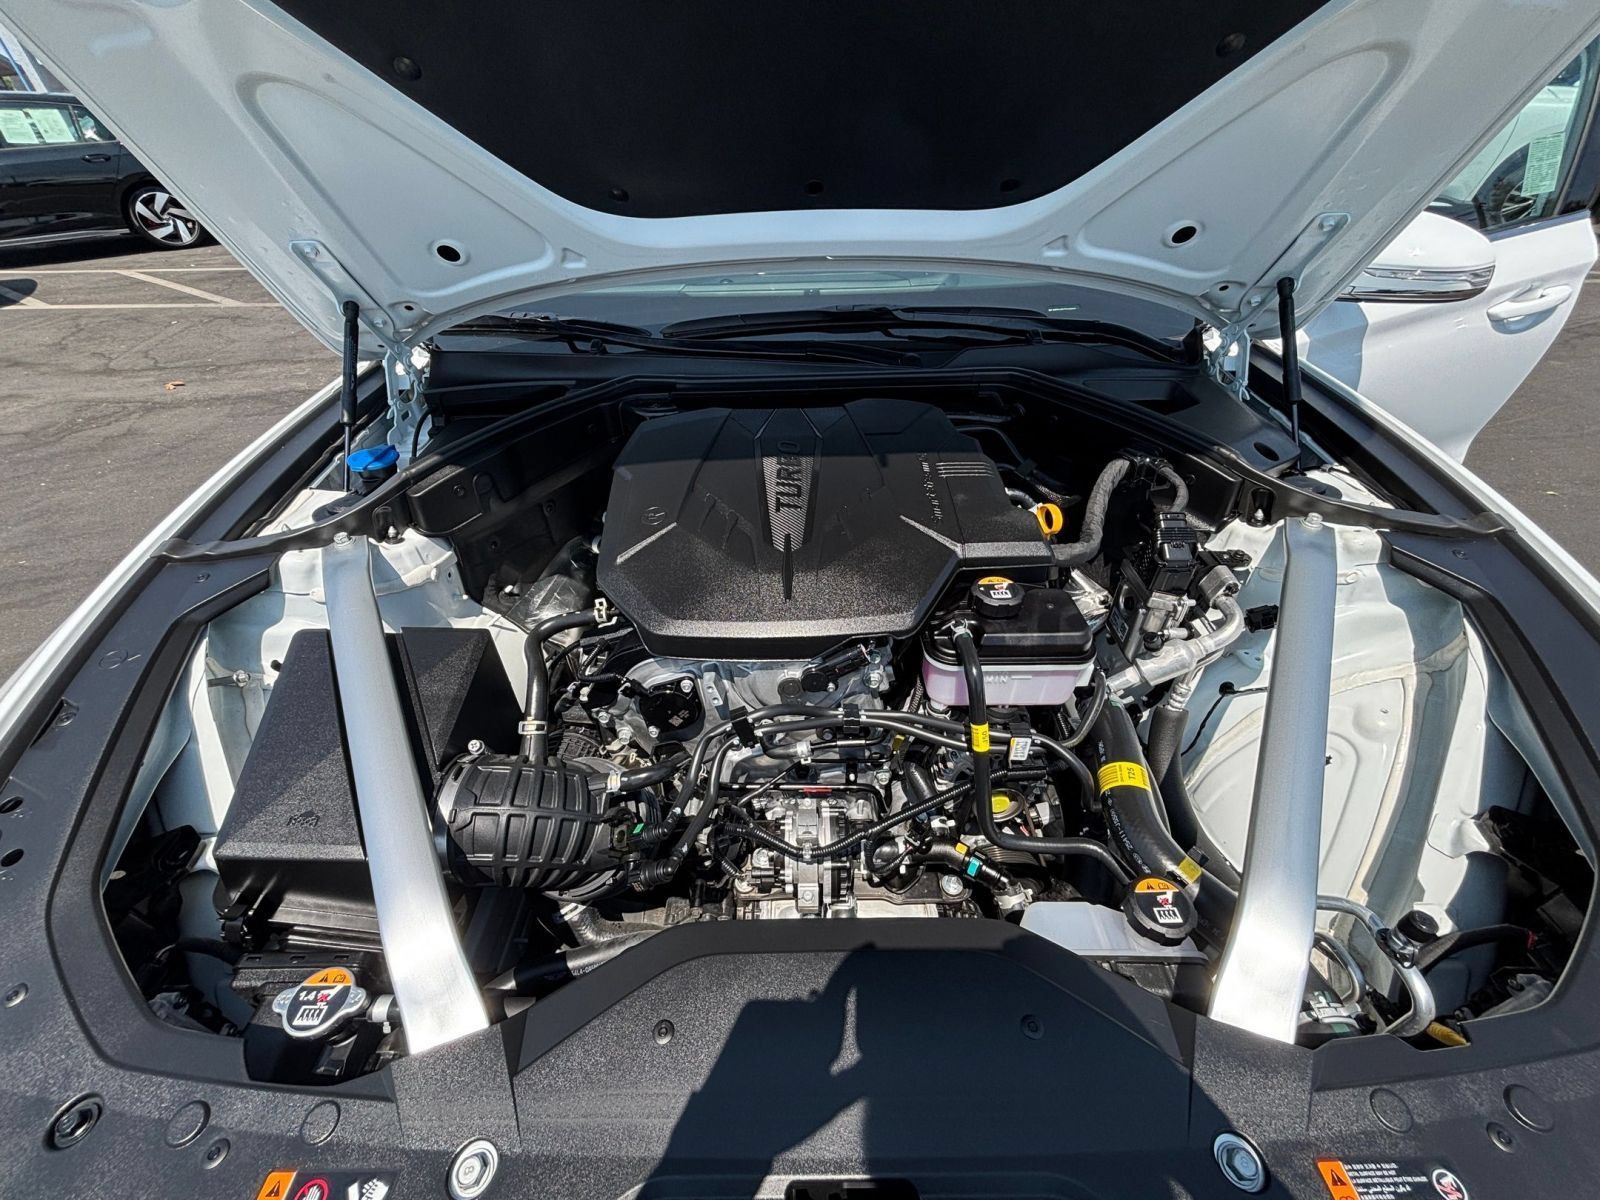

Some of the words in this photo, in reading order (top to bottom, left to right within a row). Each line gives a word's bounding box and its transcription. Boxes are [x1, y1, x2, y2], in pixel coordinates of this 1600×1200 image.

[776, 440, 803, 513] TURBO
[1127, 767, 1136, 780] T25
[298, 990, 318, 1001] 1.4
